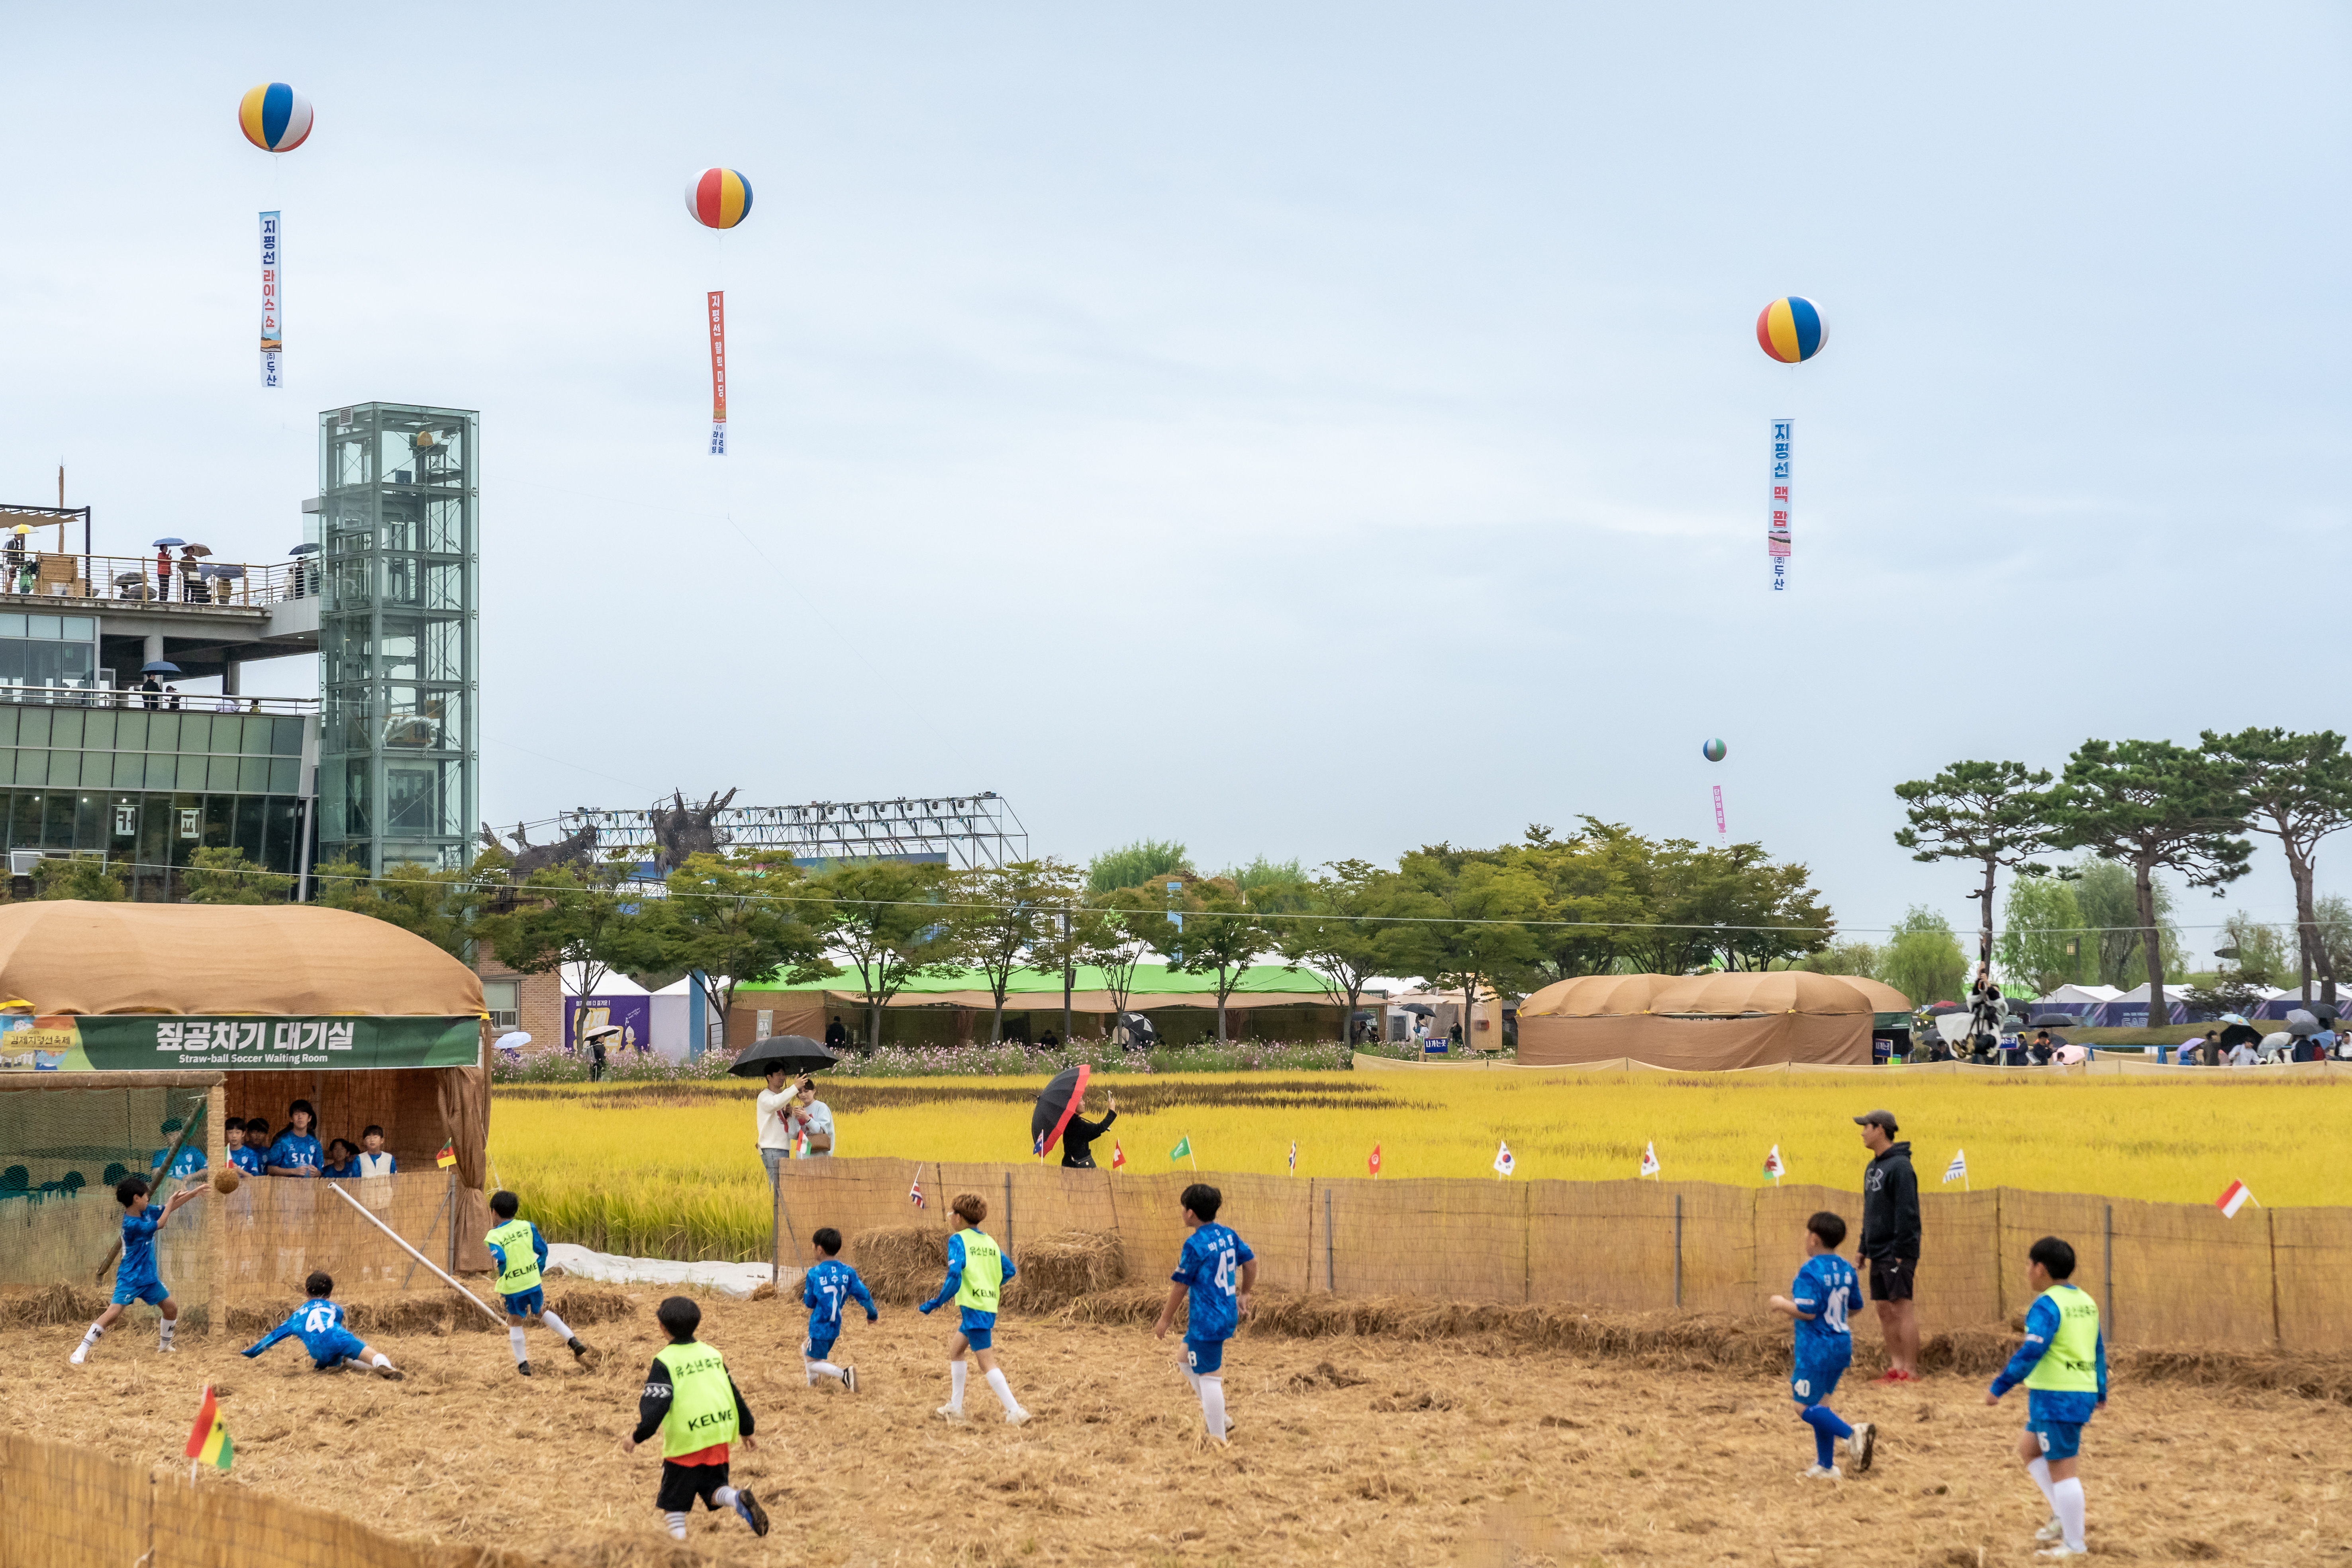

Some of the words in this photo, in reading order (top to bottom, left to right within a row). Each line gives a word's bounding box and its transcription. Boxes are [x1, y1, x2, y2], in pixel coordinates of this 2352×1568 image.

[263, 220, 276, 265] 지평선
[263, 270, 275, 310] 라이스
[265, 316, 275, 328] 쇼
[712, 295, 721, 336] 지평선
[267, 353, 277, 386] (주)두산
[1774, 424, 1790, 479] 지평선
[1774, 557, 1785, 590] (주)두산
[156, 1022, 266, 1051] 짚공차기
[274, 1022, 354, 1050] 대기실
[179, 1054, 229, 1063] Straw-ball
[231, 1054, 262, 1063] Soccer
[265, 1054, 300, 1064] Waiting
[302, 1054, 328, 1062] Room
[292, 1153, 313, 1164] SKY
[505, 1261, 538, 1280] KELME
[305, 1307, 336, 1333] 47
[1823, 1286, 1850, 1333] 40
[675, 1357, 722, 1379] 유소년축구
[688, 1409, 733, 1431] KELME
